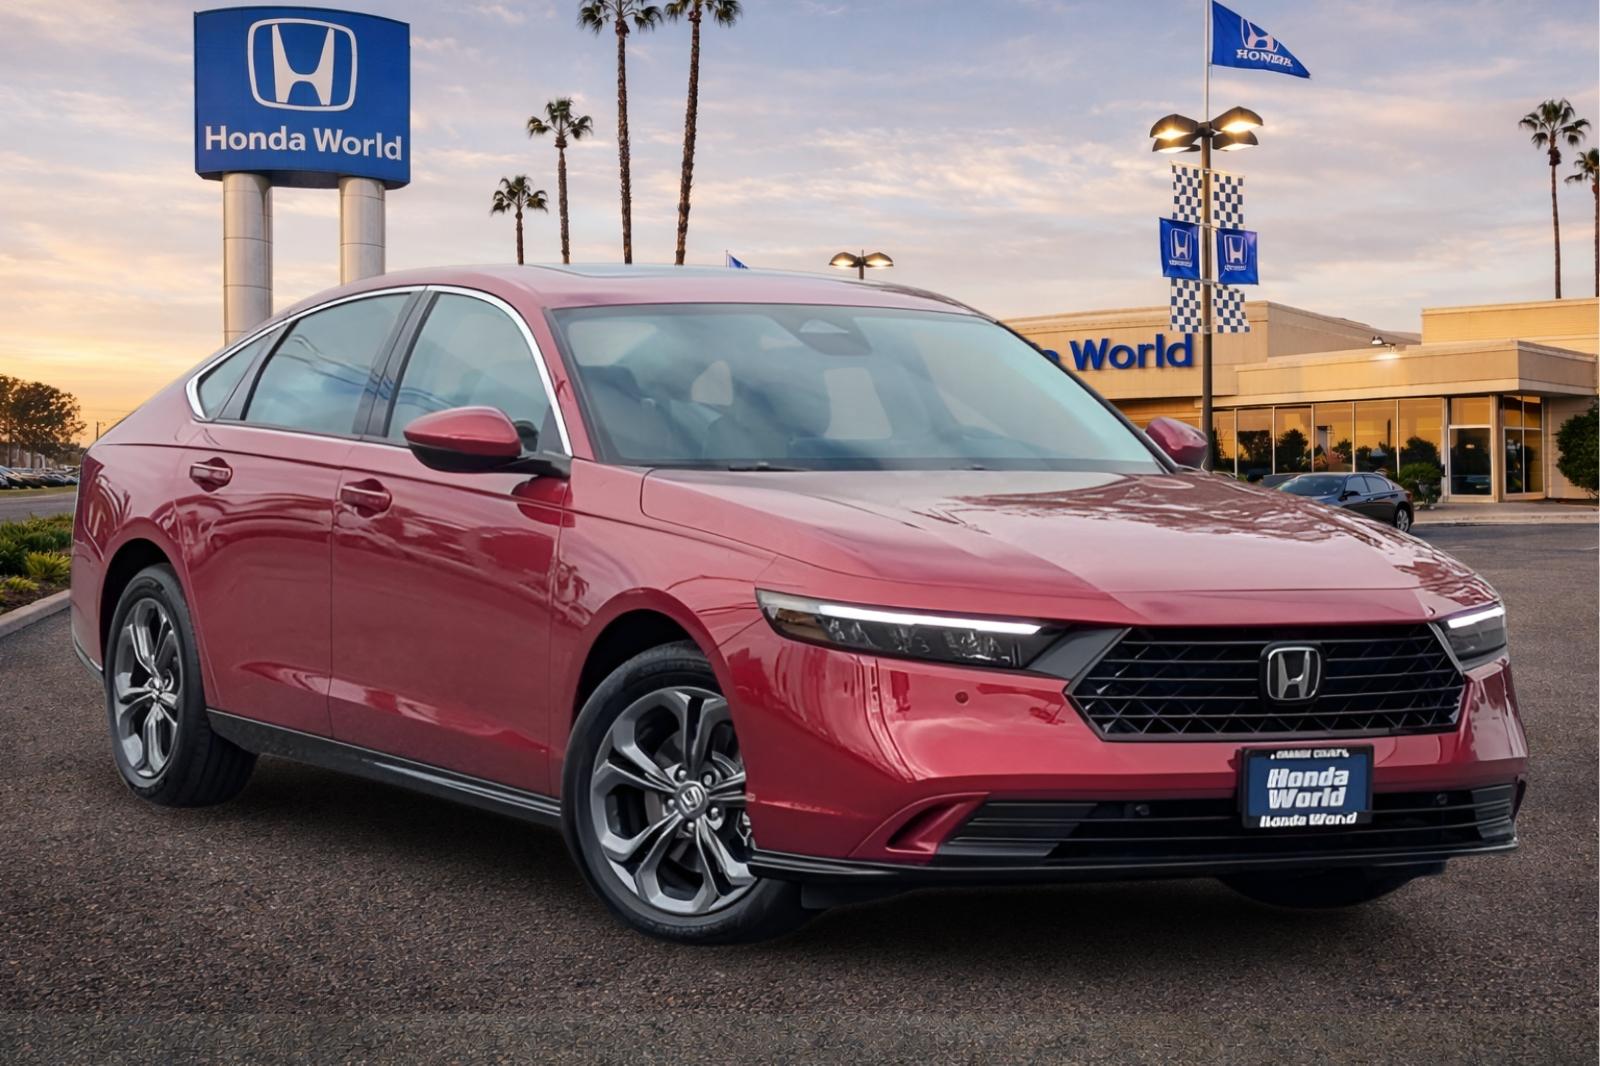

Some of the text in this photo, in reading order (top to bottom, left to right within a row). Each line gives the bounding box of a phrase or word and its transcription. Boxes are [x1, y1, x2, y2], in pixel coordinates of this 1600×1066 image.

[205, 125, 402, 160] Honda World
[1069, 333, 1193, 371] World
[1267, 766, 1350, 788] Honda
[1268, 786, 1347, 809] World
